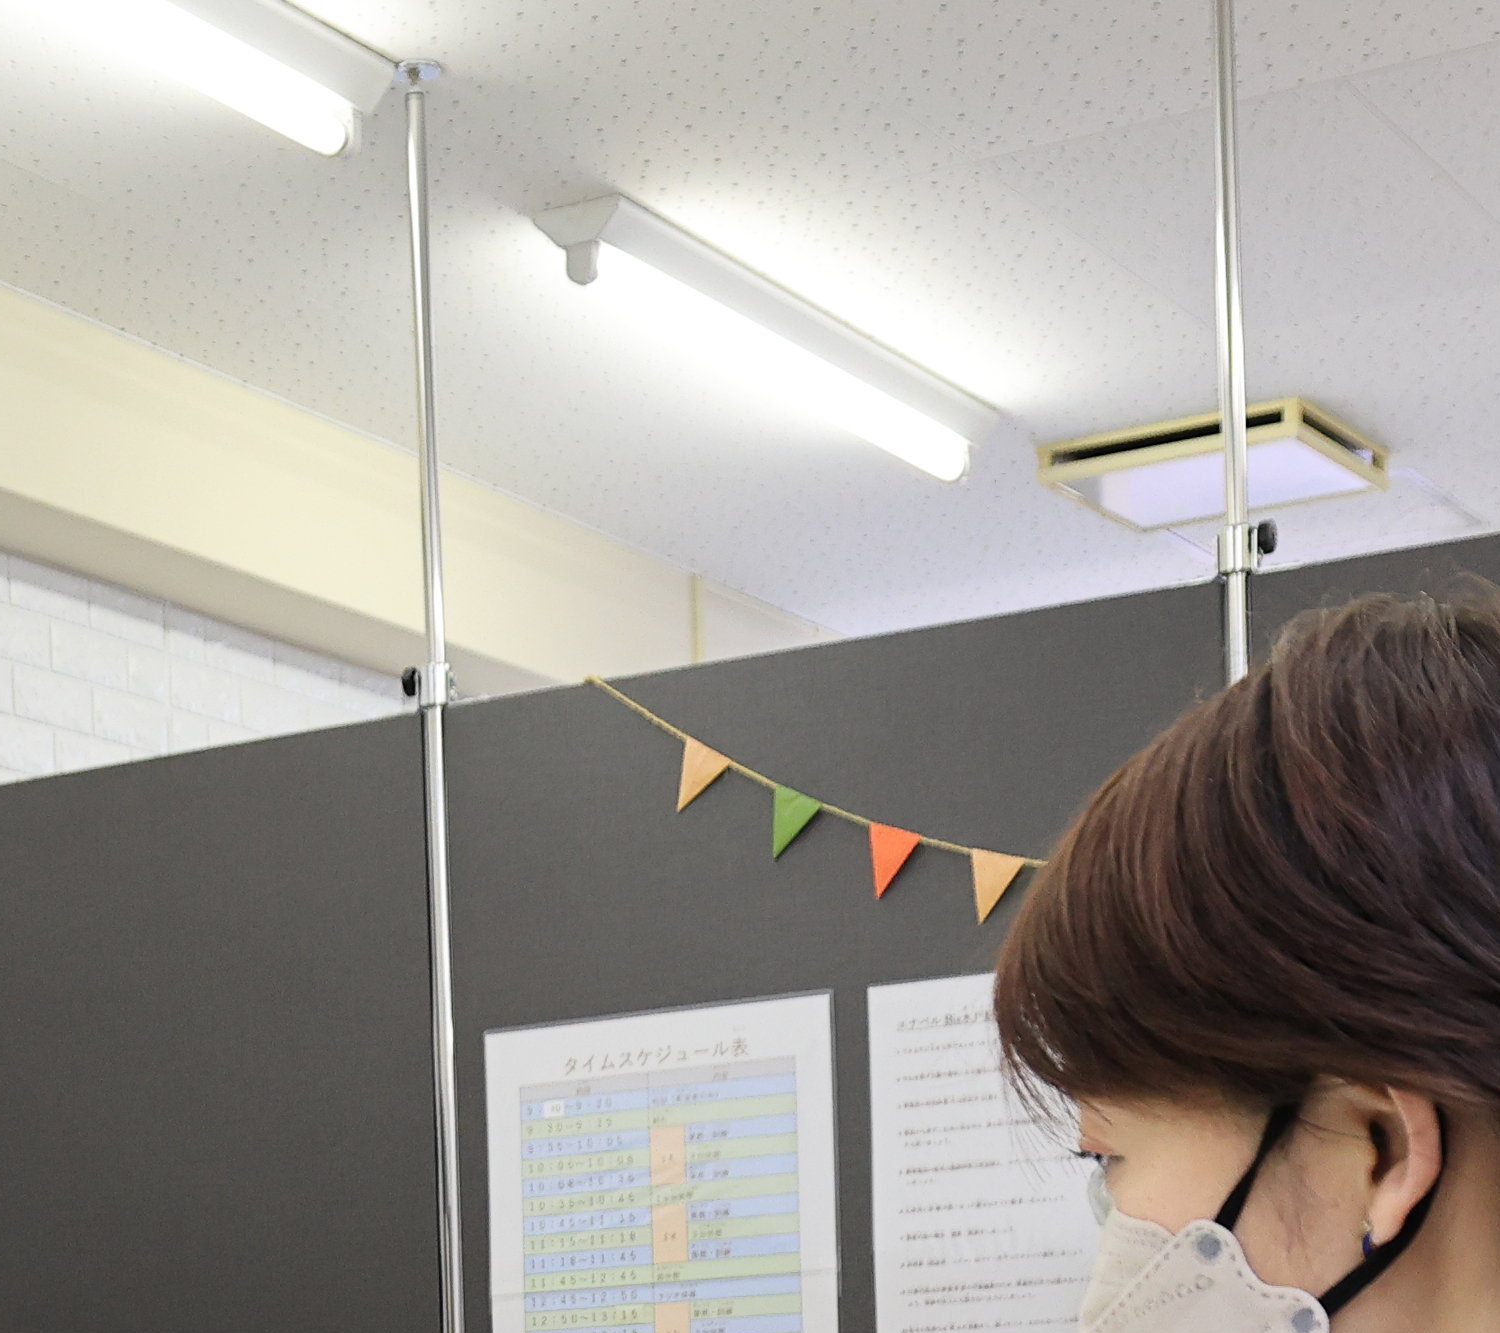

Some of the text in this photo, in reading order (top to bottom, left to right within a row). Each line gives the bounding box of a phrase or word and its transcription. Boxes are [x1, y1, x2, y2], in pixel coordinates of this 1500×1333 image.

[564, 1037, 750, 1075] タイムスケジュール表
